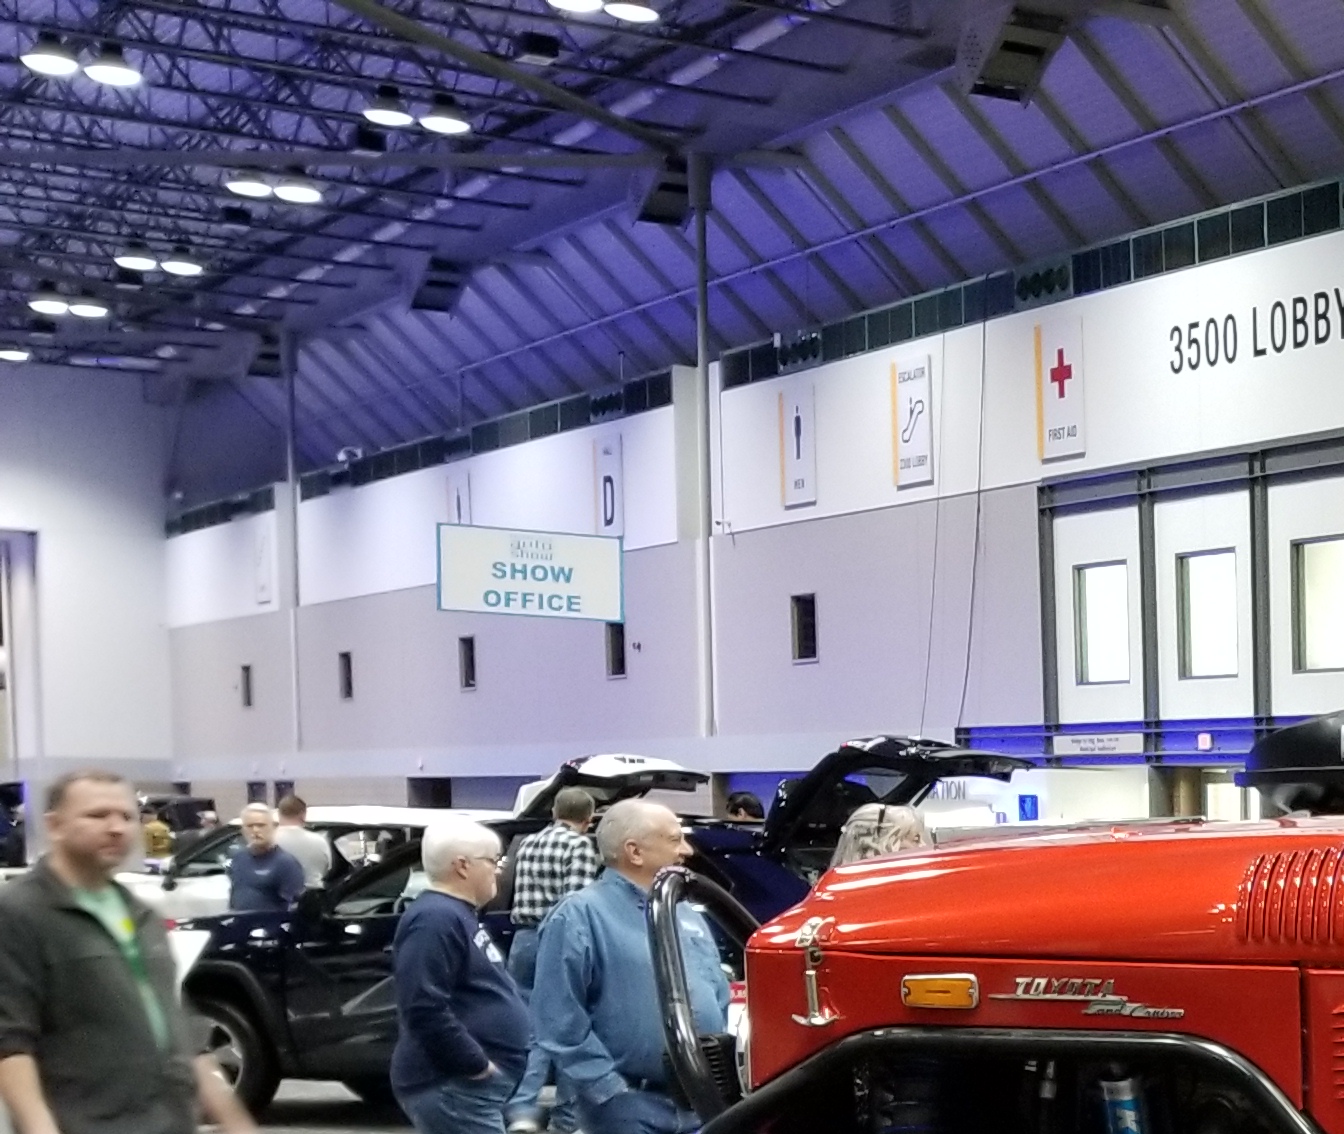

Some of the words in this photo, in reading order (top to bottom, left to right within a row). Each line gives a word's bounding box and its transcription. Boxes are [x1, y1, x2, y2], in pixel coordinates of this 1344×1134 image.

[1169, 314, 1238, 375] 3500
[1048, 426, 1066, 443] FIRST
[1066, 424, 1078, 438] AID
[602, 475, 615, 527] D
[491, 561, 574, 584] SHOW
[482, 589, 582, 613] OFFICE
[1014, 977, 1115, 997] TOYOTA
